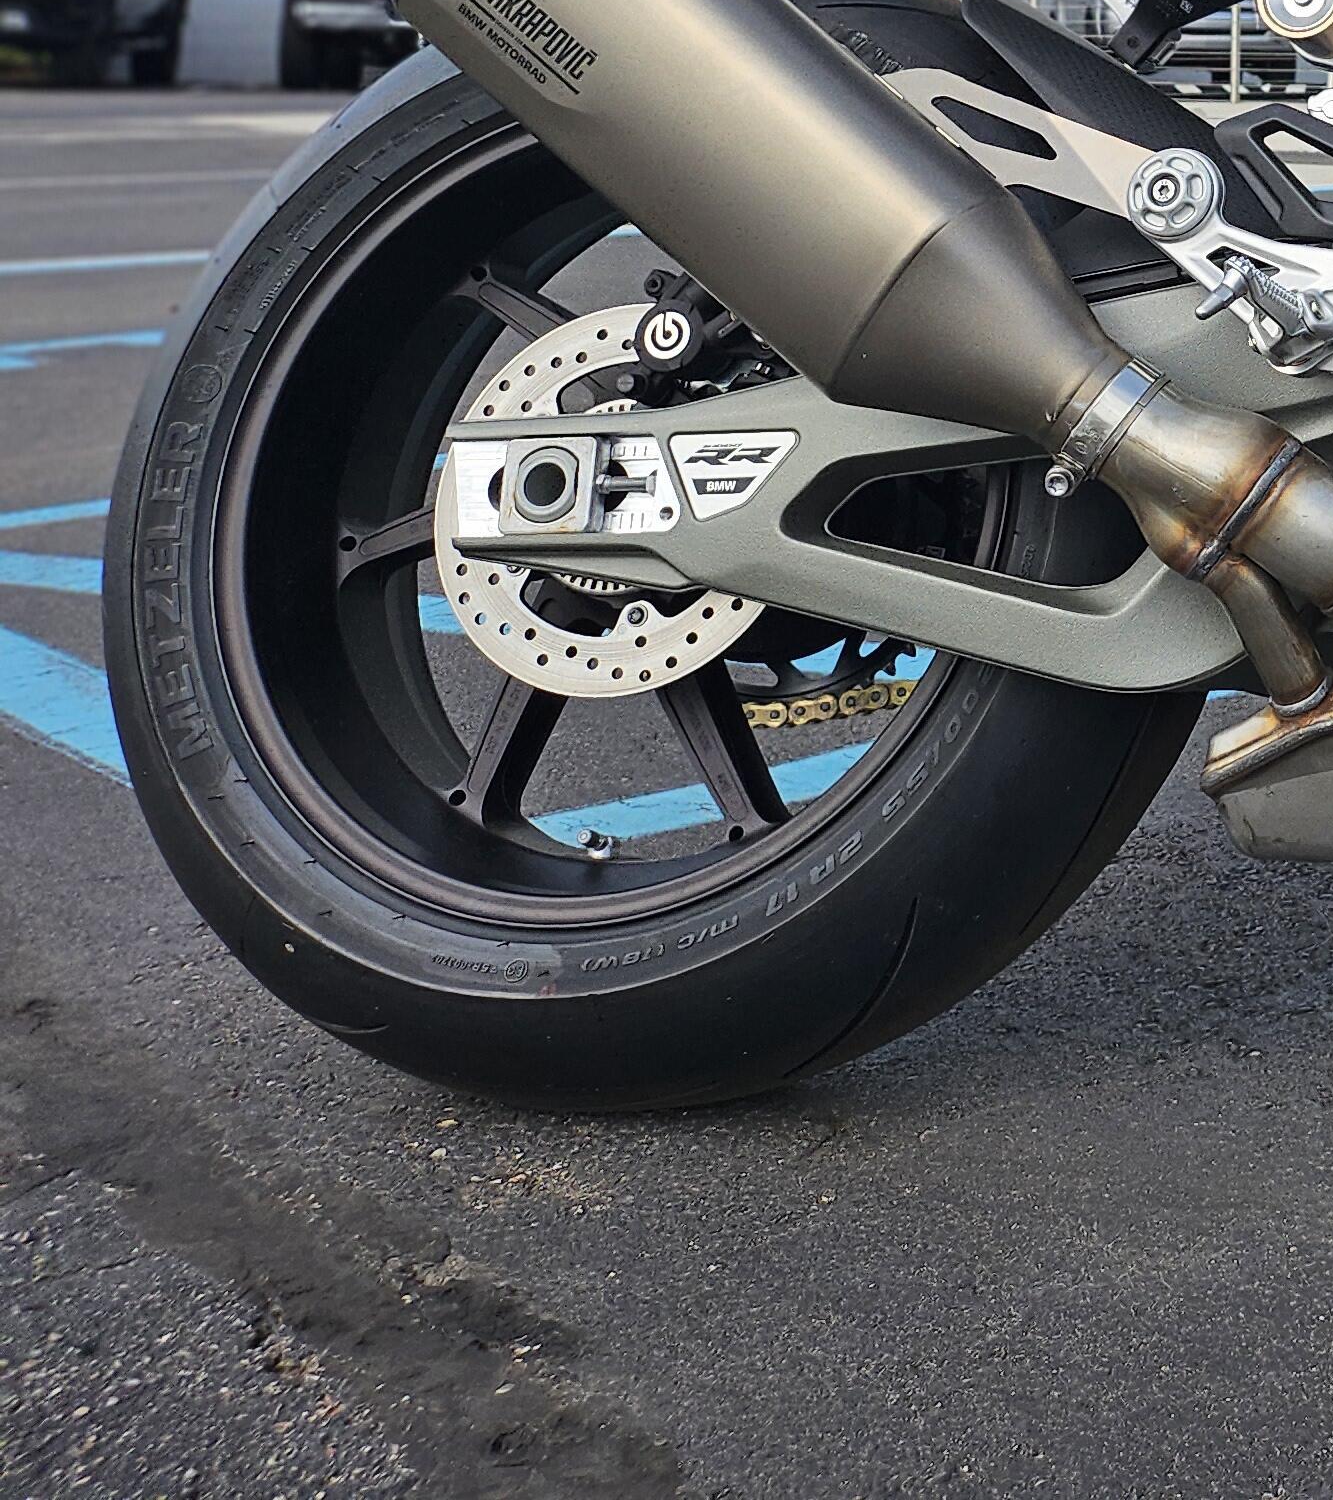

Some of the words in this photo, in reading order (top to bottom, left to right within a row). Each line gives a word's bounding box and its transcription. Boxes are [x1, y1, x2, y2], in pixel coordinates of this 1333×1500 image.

[457, 3, 486, 33] BMW
[486, 28, 548, 85] MOTORRAD
[706, 480, 737, 492] BMW
[140, 418, 214, 764] METZELER
[765, 881, 800, 916] 17
